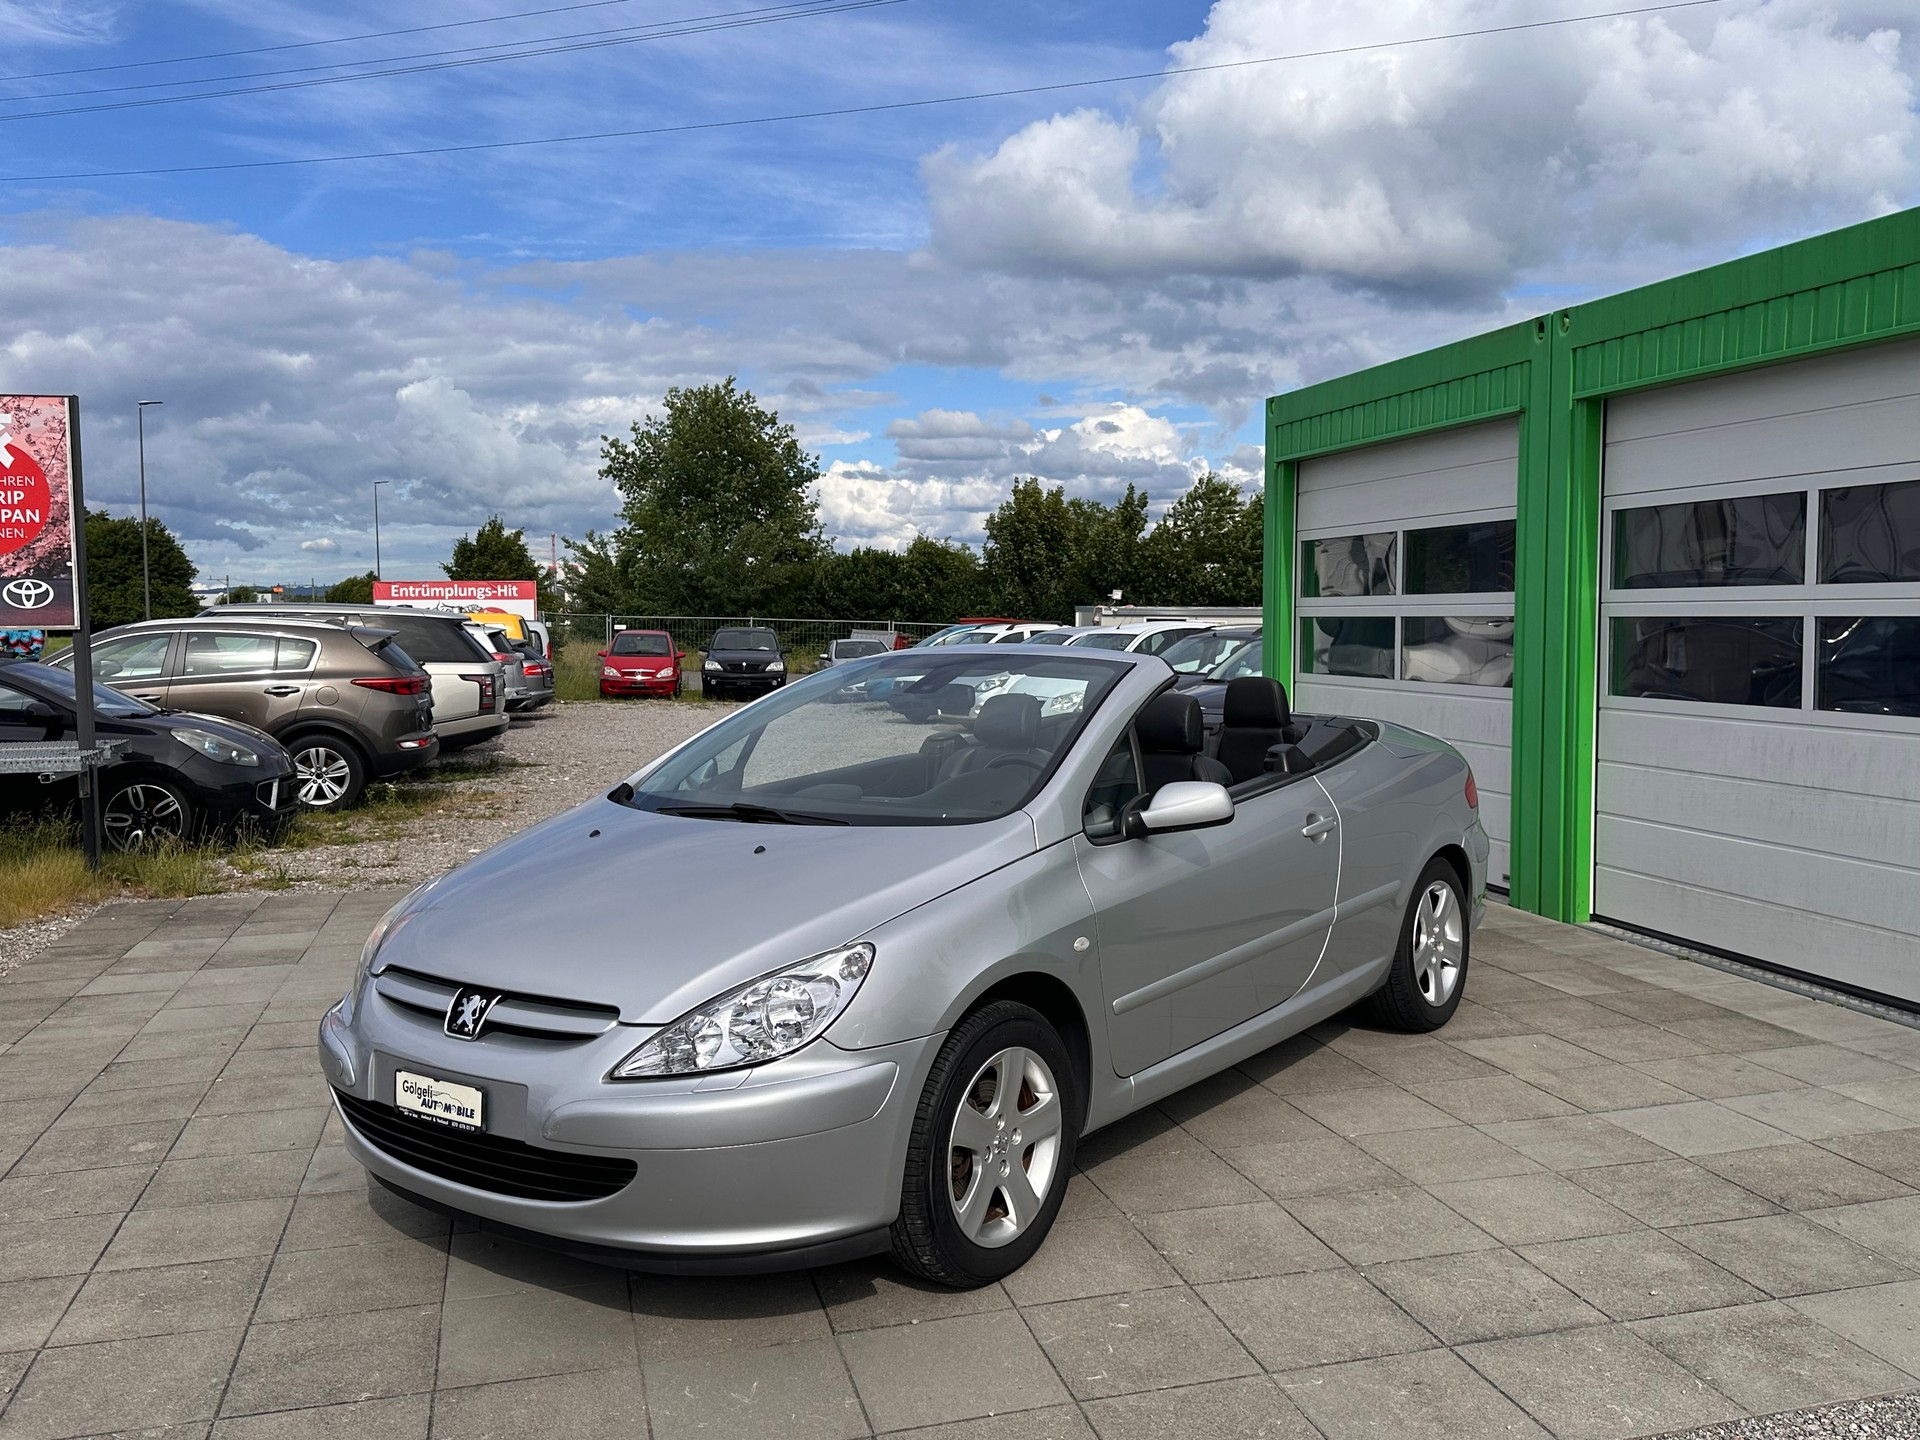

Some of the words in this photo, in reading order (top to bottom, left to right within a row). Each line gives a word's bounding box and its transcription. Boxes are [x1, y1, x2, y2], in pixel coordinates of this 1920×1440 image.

[1, 508, 40, 523] PAN
[391, 584, 518, 599] Entrümplungs-Hit
[402, 1080, 433, 1099] Gölgeli
